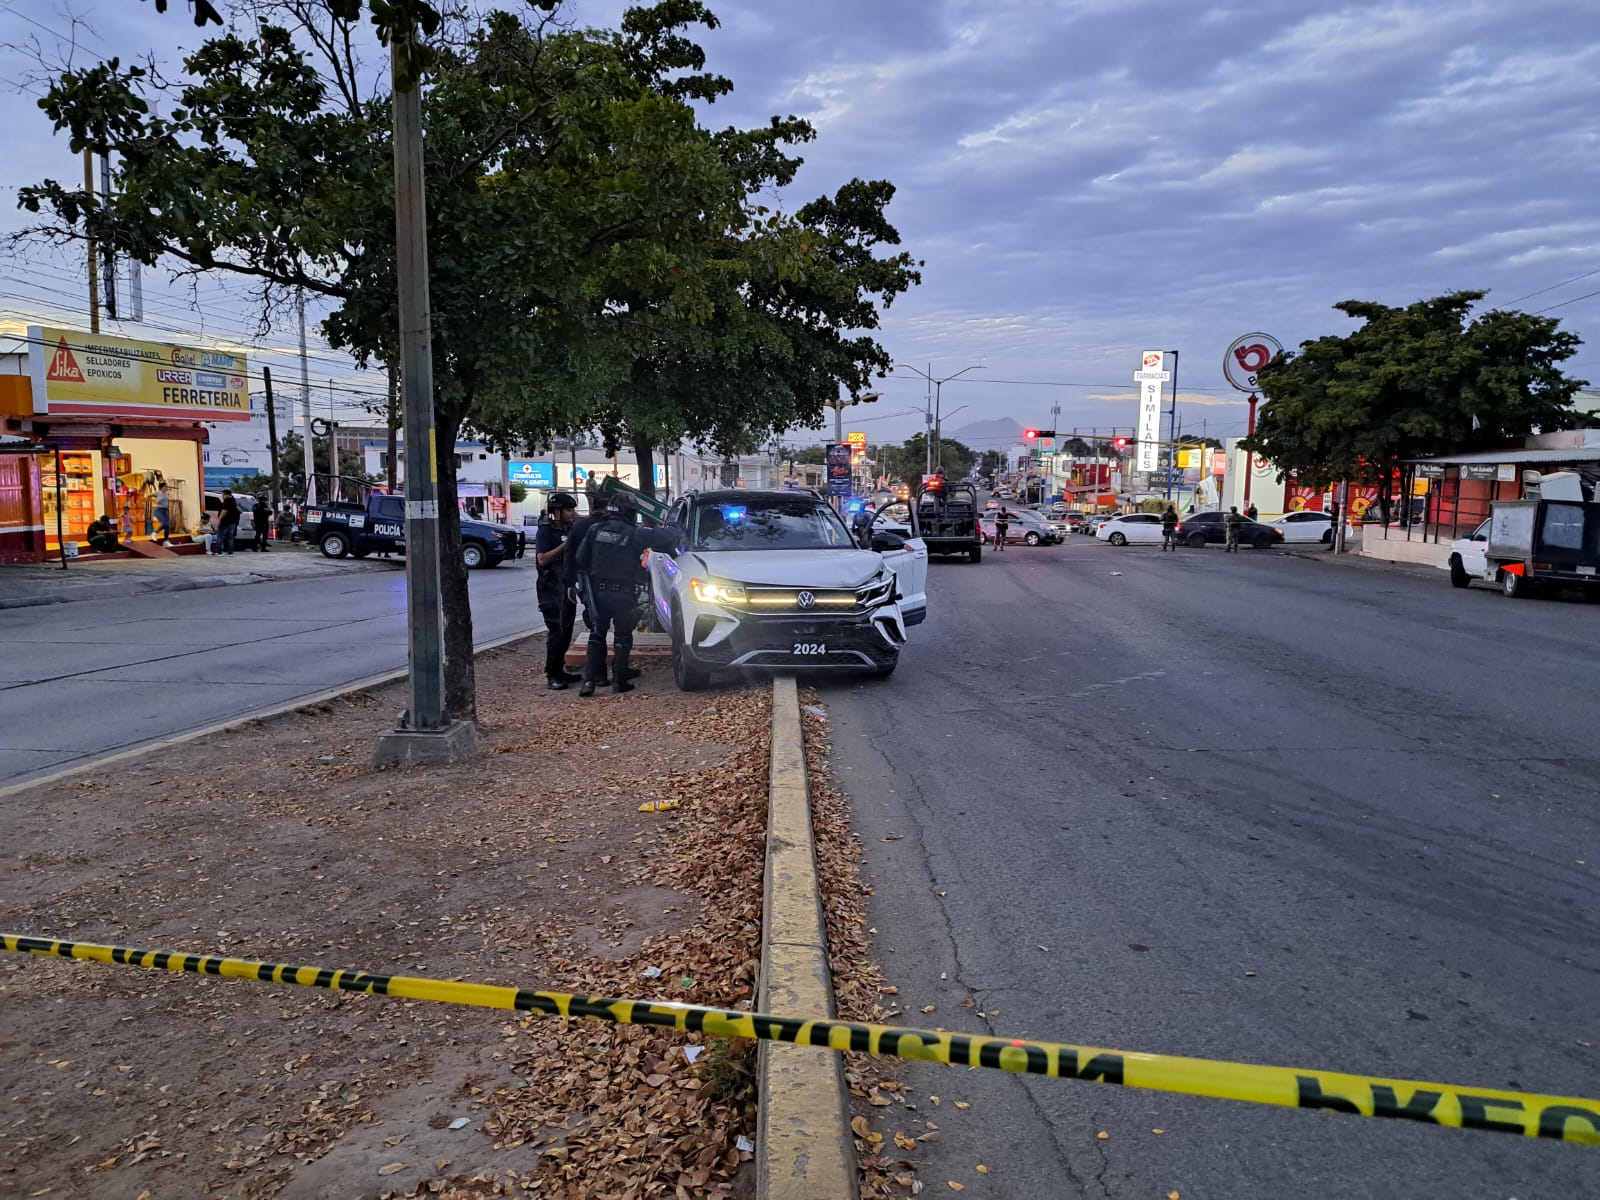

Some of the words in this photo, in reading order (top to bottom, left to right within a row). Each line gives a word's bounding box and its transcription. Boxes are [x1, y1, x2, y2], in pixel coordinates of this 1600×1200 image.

[85, 343, 161, 360] IMPERMEABILIZANTES
[51, 350, 80, 378] Sika
[86, 356, 131, 368] SELLADORES
[87, 368, 122, 380] EPOXICOS
[157, 369, 192, 385] URREA
[1136, 372, 1168, 380] FARMACIAS
[163, 387, 241, 408] FERRETERIA
[1143, 384, 1156, 469] SIMILARES
[374, 523, 401, 537] POLICÍA
[793, 643, 826, 655] 2024
